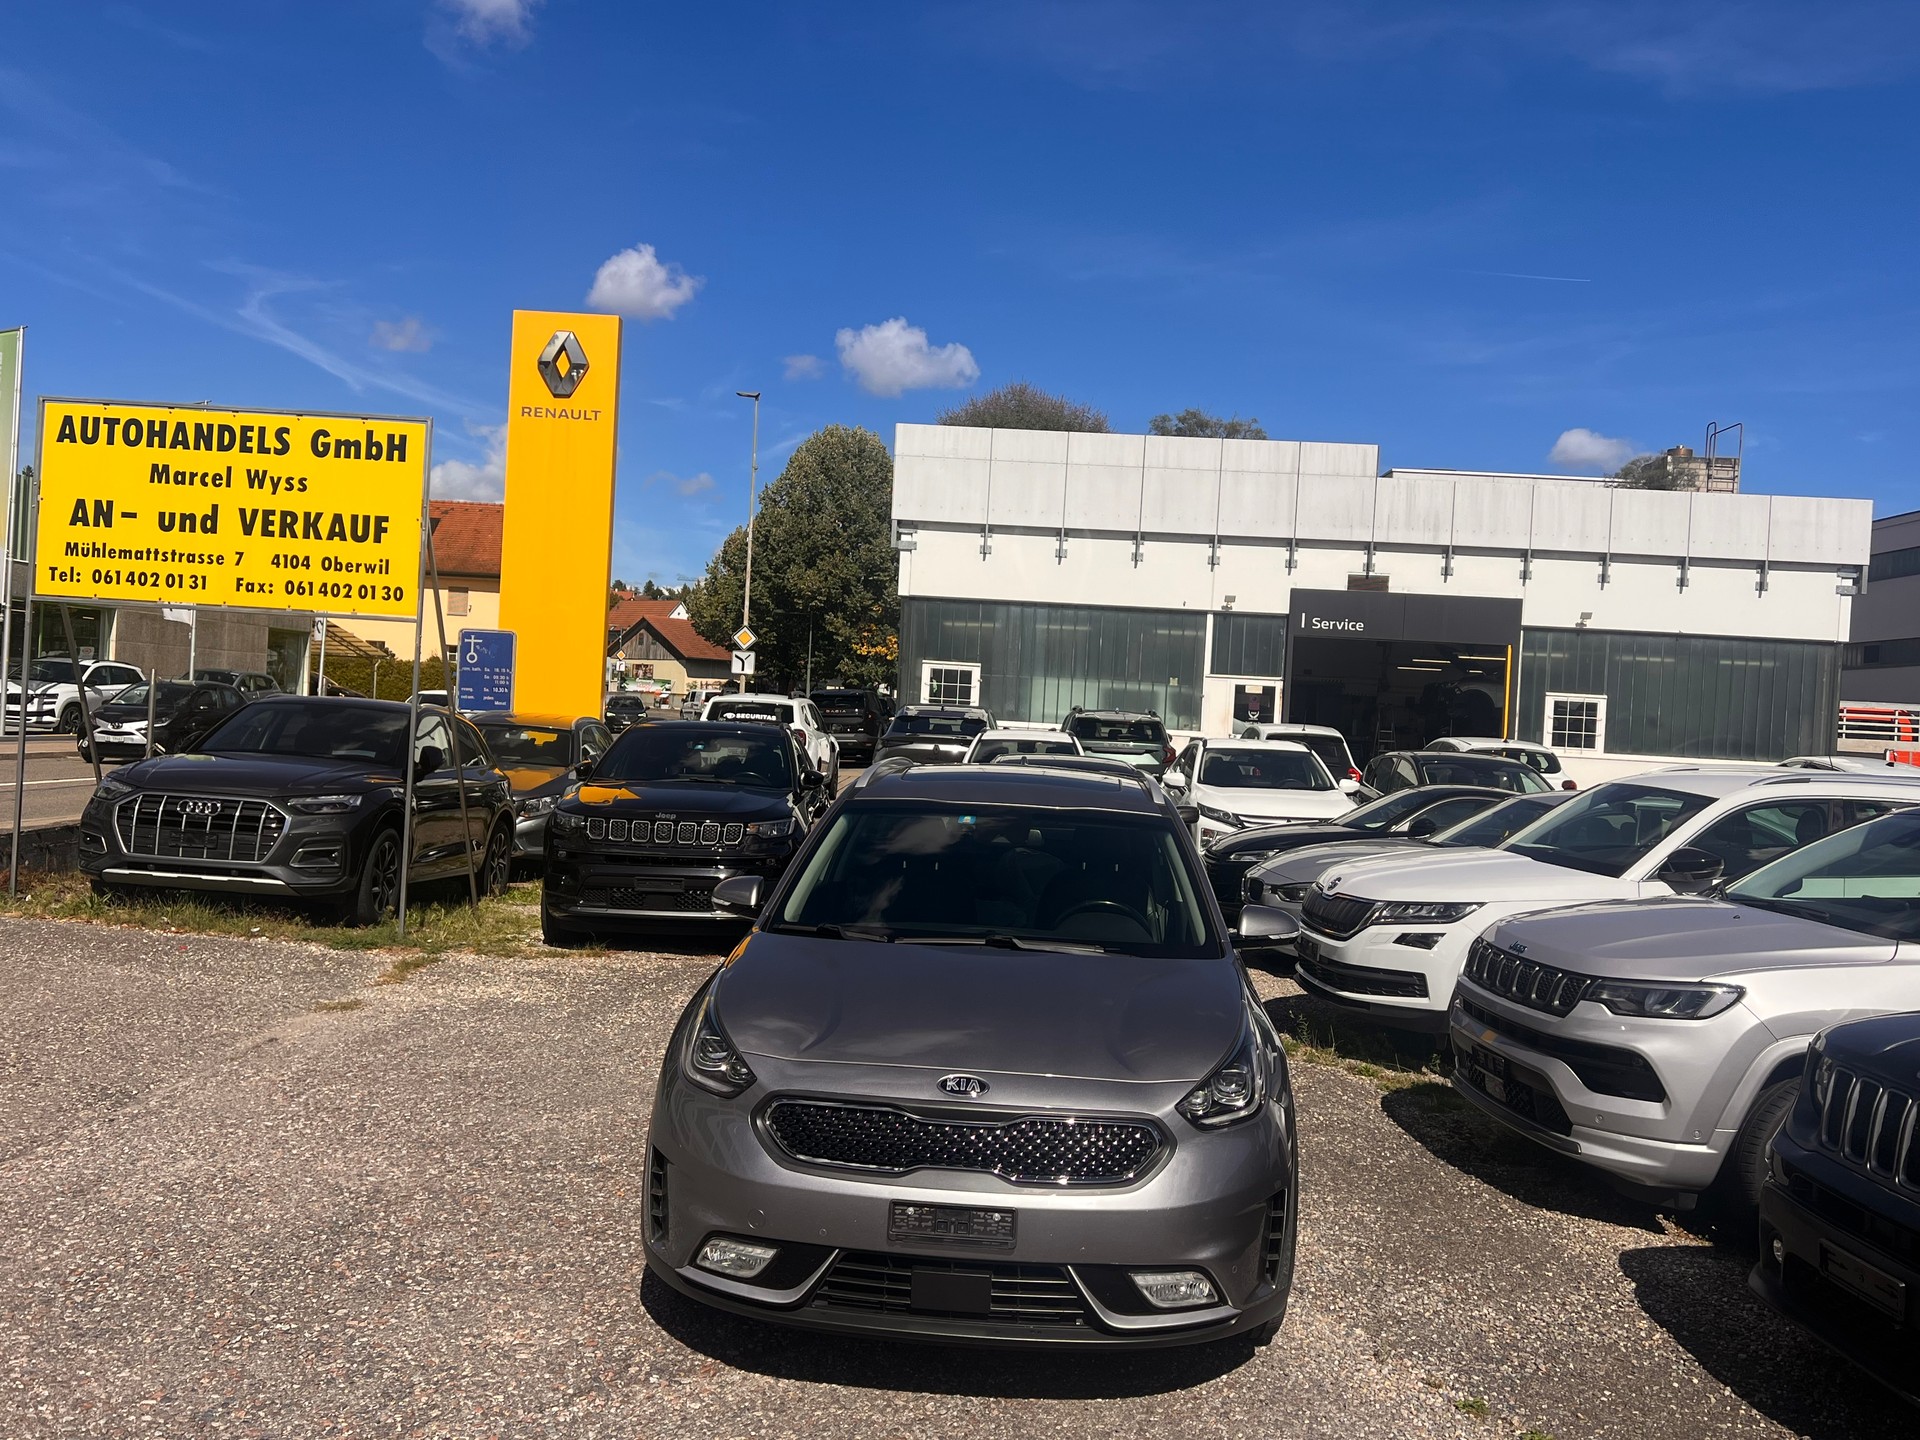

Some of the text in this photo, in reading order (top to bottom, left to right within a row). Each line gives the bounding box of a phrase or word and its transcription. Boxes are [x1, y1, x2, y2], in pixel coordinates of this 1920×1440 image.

[521, 406, 602, 421] RENAULT
[56, 415, 408, 463] AUTOHANDELS GmbH
[149, 463, 308, 495] Marcel Wyss
[158, 503, 219, 534] und
[238, 507, 390, 544] VERKAUF
[64, 541, 390, 575] Mühlemattstrasse 7 4104 Oberwil
[49, 566, 81, 583] Tel:
[235, 577, 274, 594] Fax:
[1311, 617, 1365, 632] Service
[736, 713, 777, 721] SECURITAS
[655, 812, 677, 820] Jeep
[946, 1078, 981, 1093] KIA
